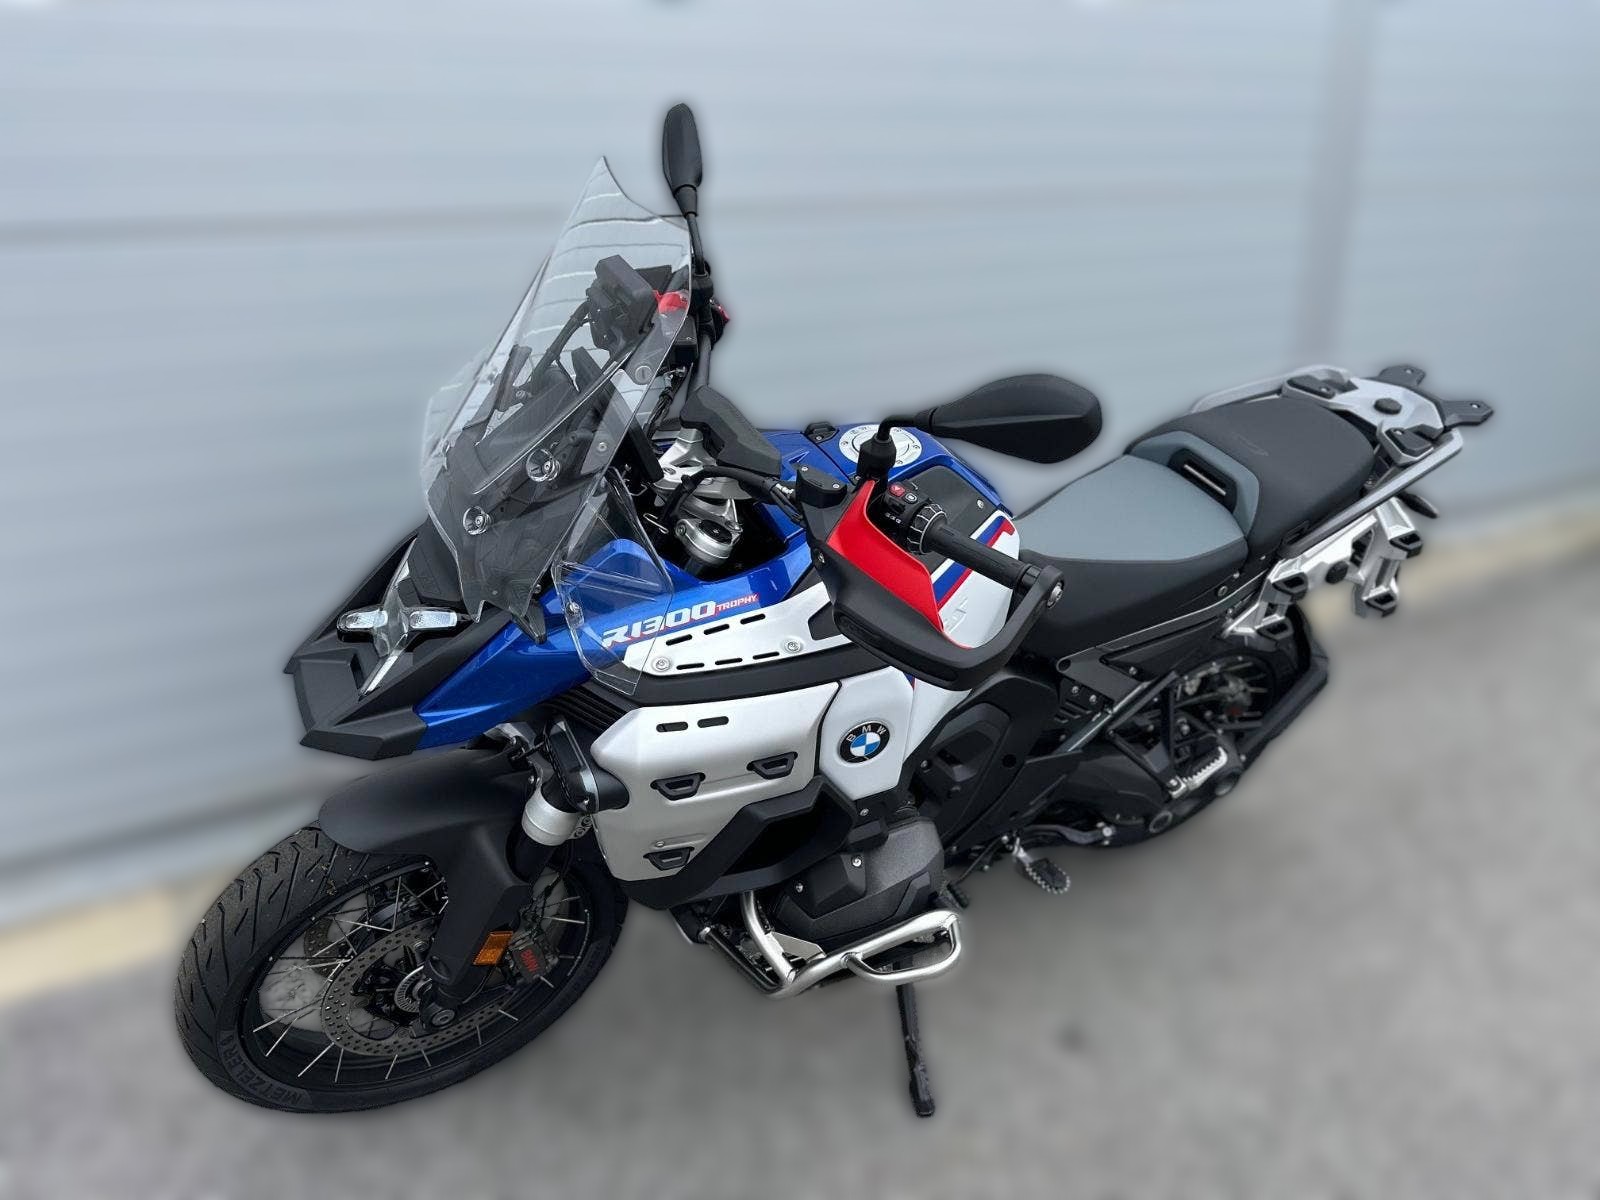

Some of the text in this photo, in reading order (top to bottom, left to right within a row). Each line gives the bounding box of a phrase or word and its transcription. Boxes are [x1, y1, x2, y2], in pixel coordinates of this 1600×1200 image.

[716, 593, 759, 613] TROPHY
[846, 724, 887, 742] BMW
[219, 1043, 306, 1107] METZELER
